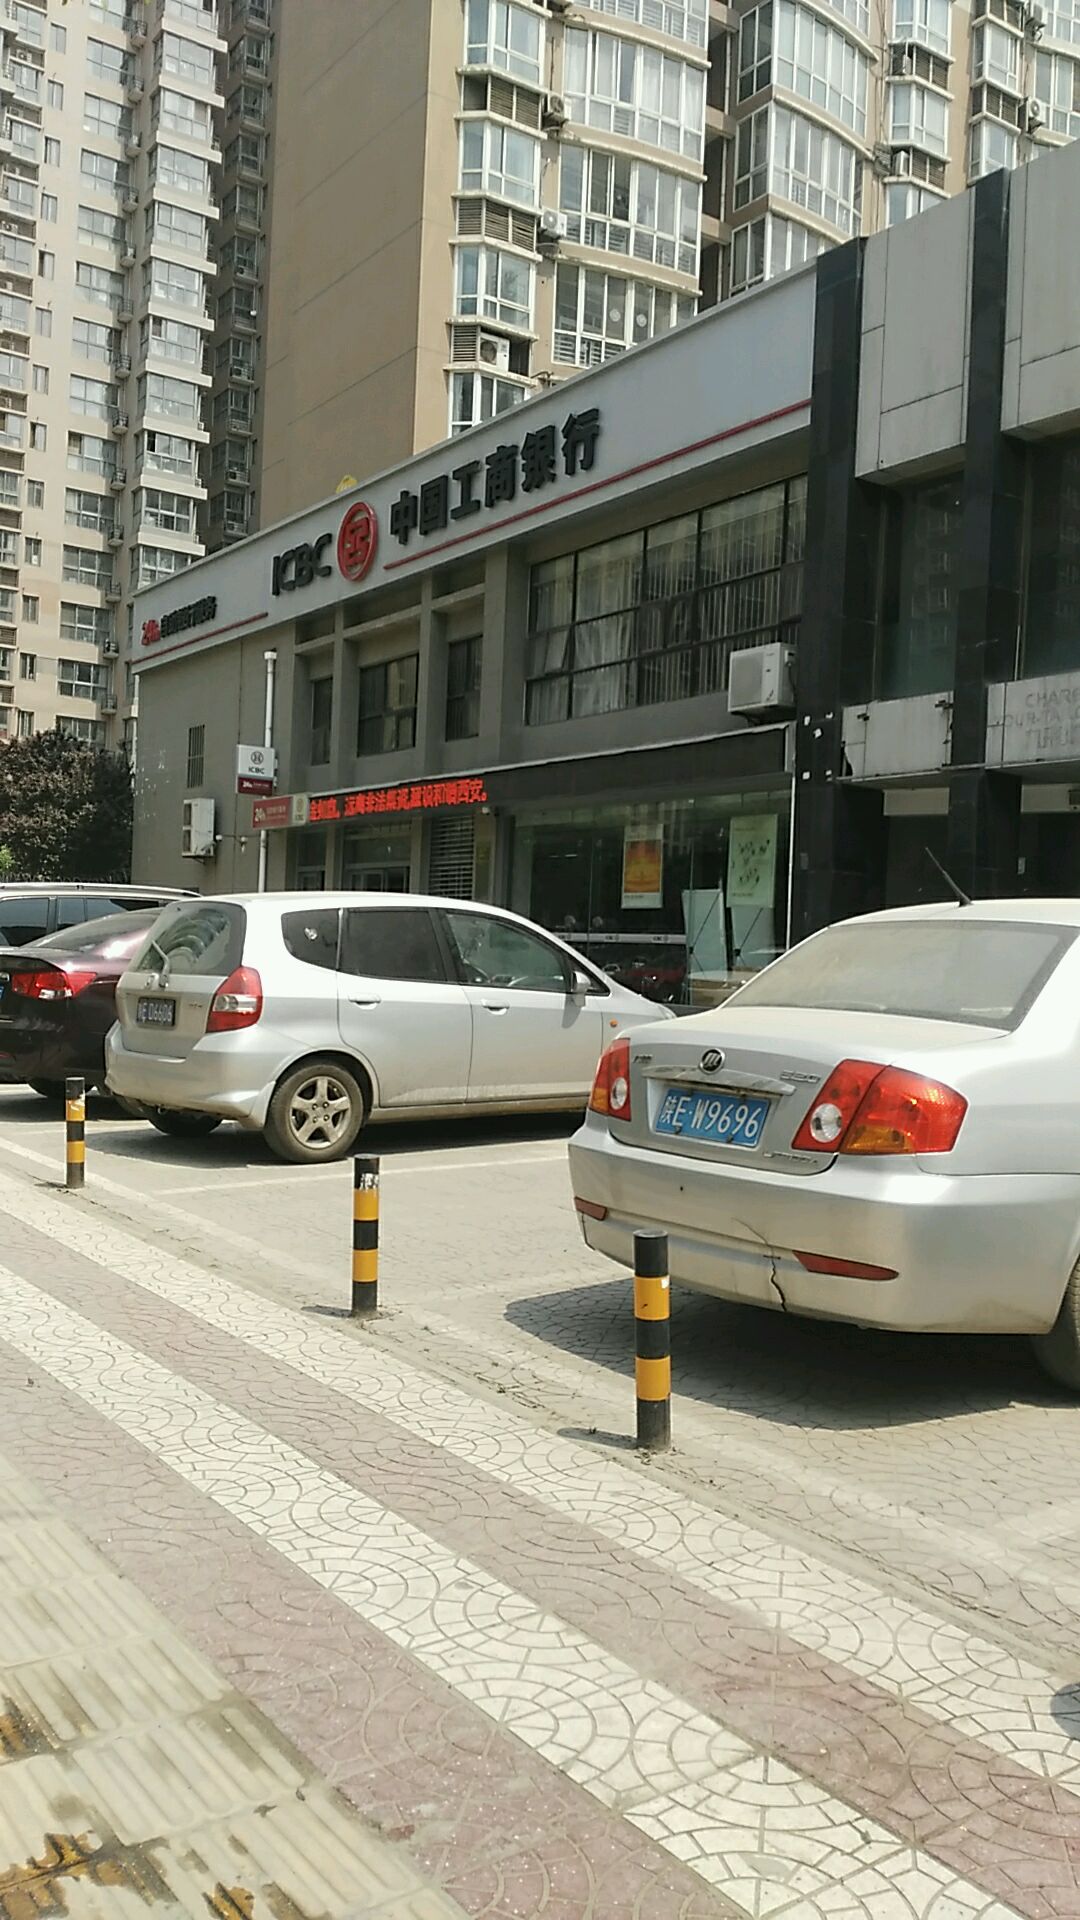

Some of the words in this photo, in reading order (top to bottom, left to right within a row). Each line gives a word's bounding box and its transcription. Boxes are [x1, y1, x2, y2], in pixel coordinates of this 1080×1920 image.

[390, 408, 600, 546] 中国工商银行
[271, 533, 332, 596] ICBC
[248, 766, 265, 775] ICBC
